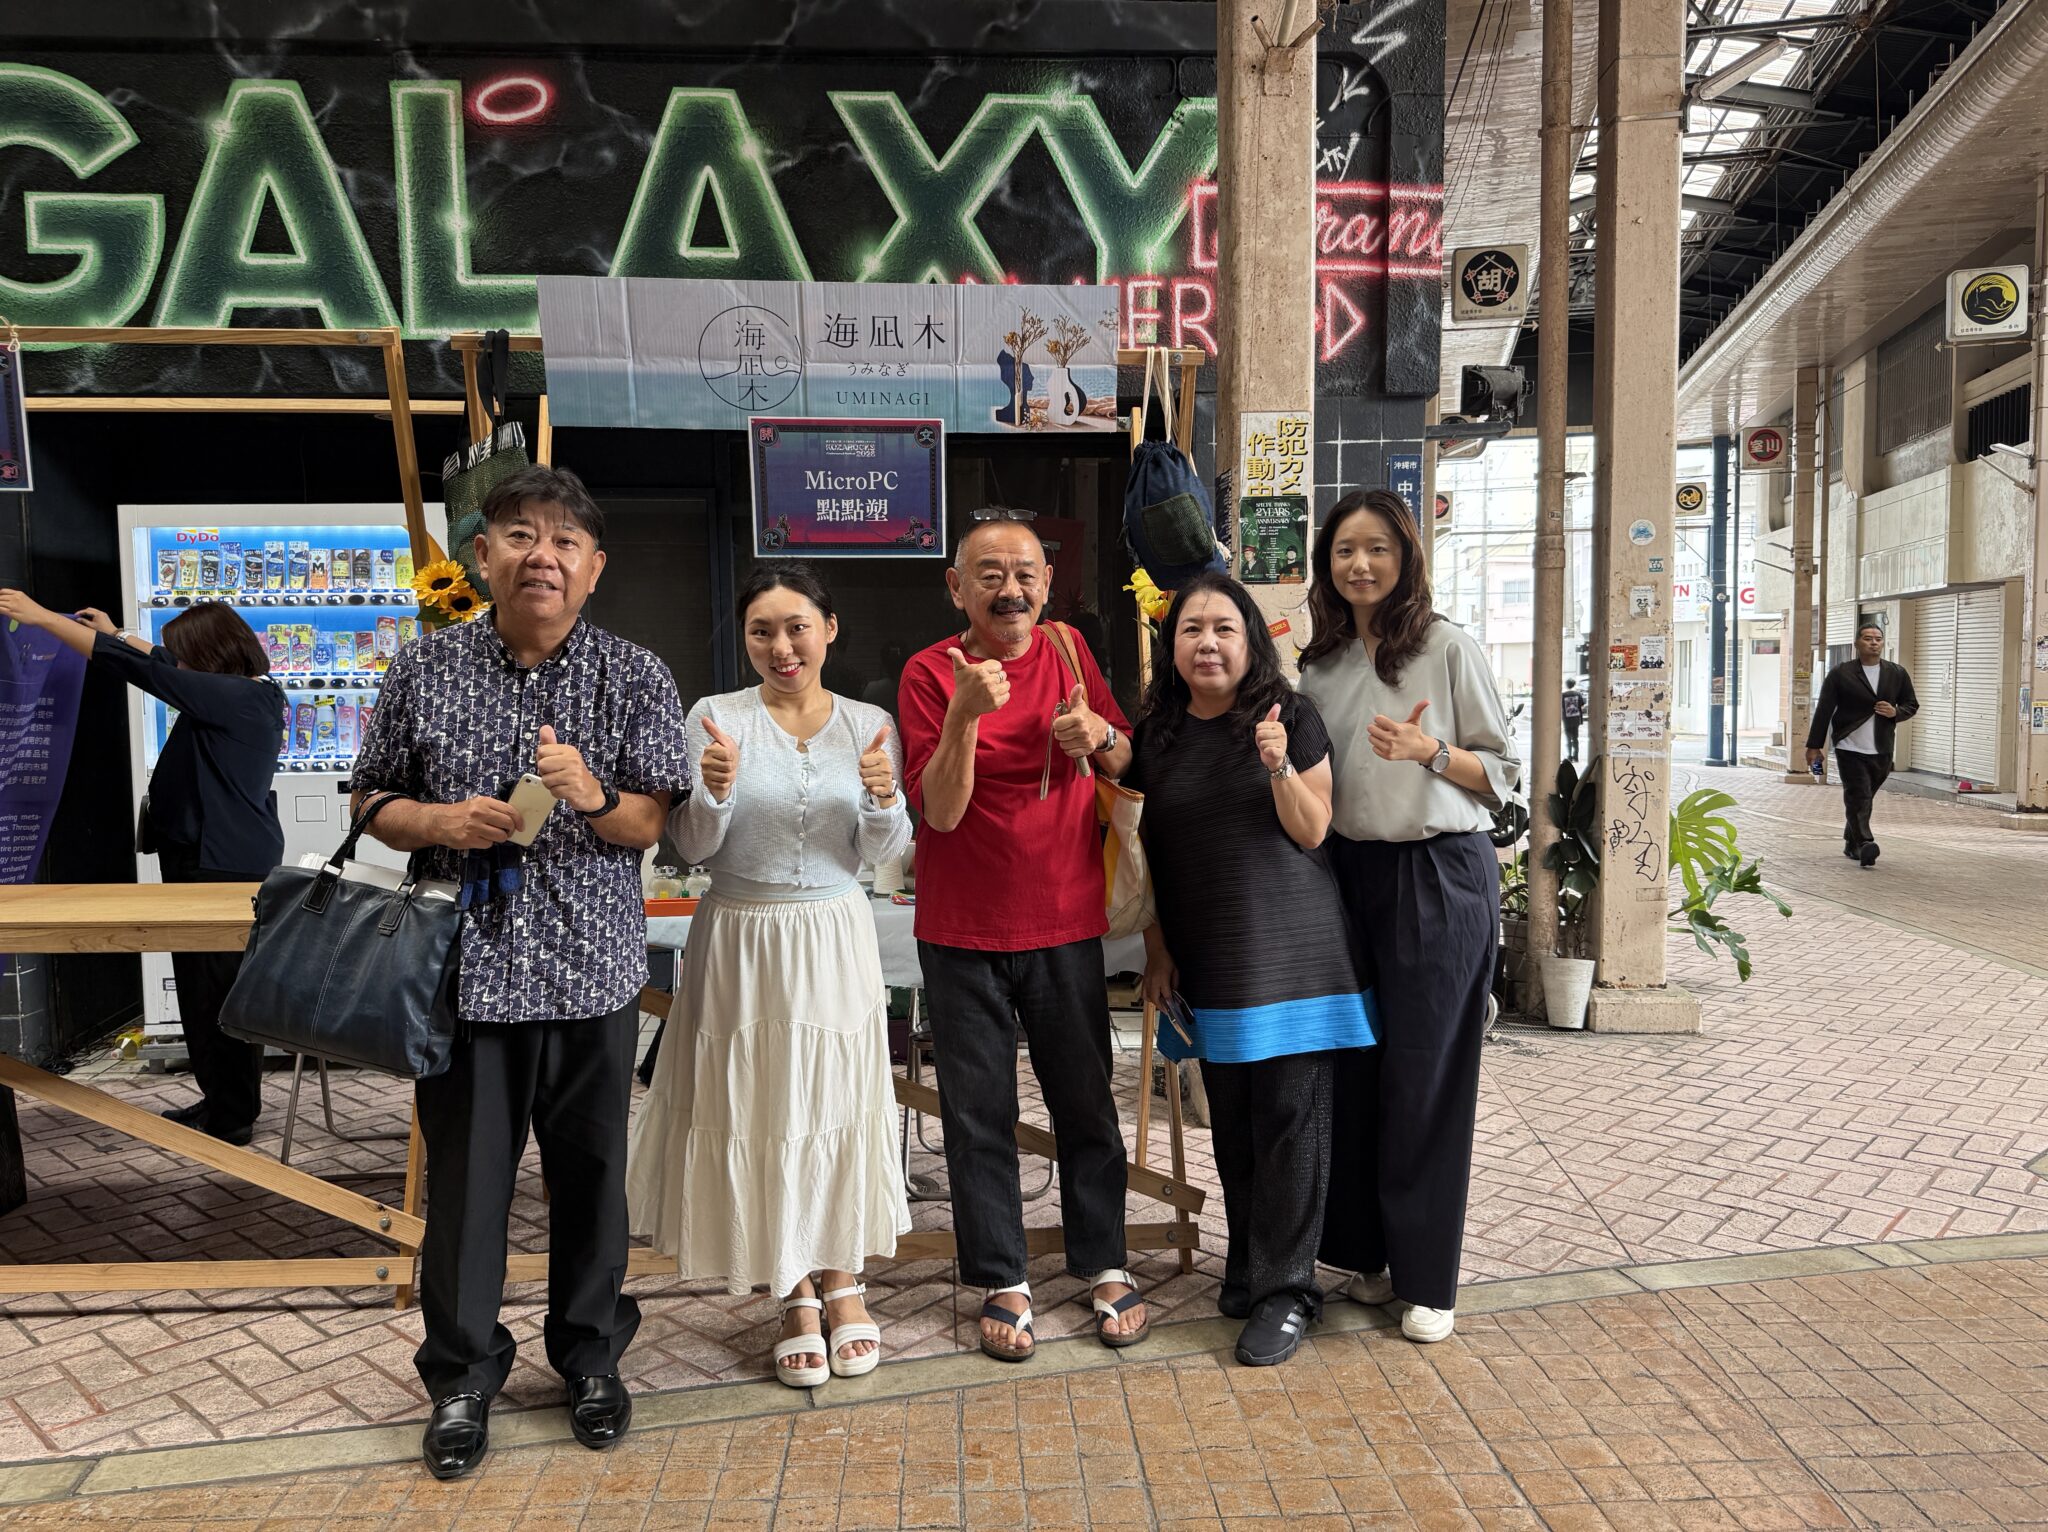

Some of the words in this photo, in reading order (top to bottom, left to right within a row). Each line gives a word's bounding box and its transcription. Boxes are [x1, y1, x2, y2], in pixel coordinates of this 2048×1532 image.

[0, 62, 1218, 350] GALAXY
[1477, 268, 1502, 292] 胡
[846, 361, 911, 378] うみなぎ
[835, 390, 931, 407] UMINAGI
[1750, 439, 1780, 454] 室川
[1393, 460, 1417, 470] 沖縄市
[804, 470, 899, 491] MicroPC
[816, 498, 889, 522] 點點塑
[176, 532, 219, 544] DyDo
[13, 833, 39, 843] provide
